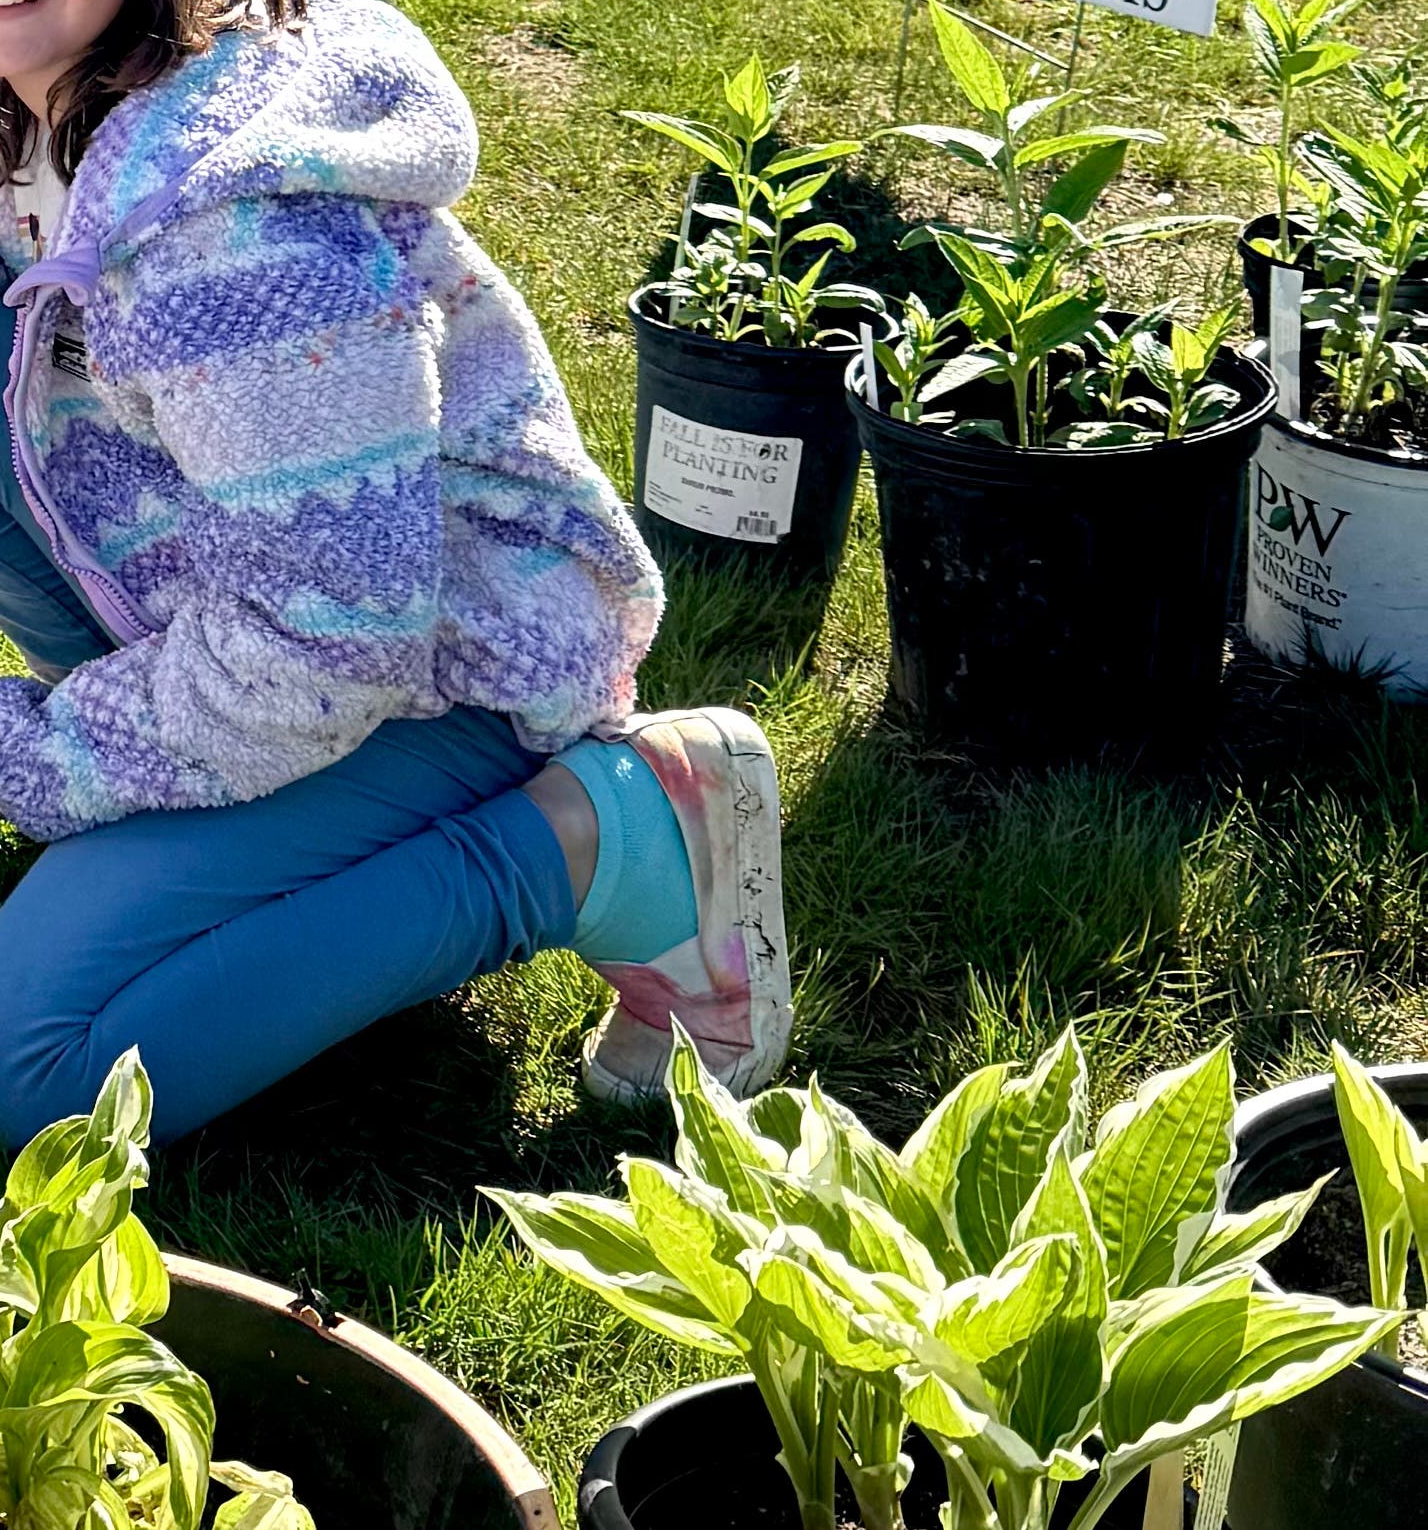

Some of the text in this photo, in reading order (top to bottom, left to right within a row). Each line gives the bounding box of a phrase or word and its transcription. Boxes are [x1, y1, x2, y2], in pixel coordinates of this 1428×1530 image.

[660, 415, 789, 462] FALL IS FOR
[663, 440, 779, 484] PLANTING
[1256, 461, 1352, 558] PW
[1257, 525, 1332, 583] PROVEN
